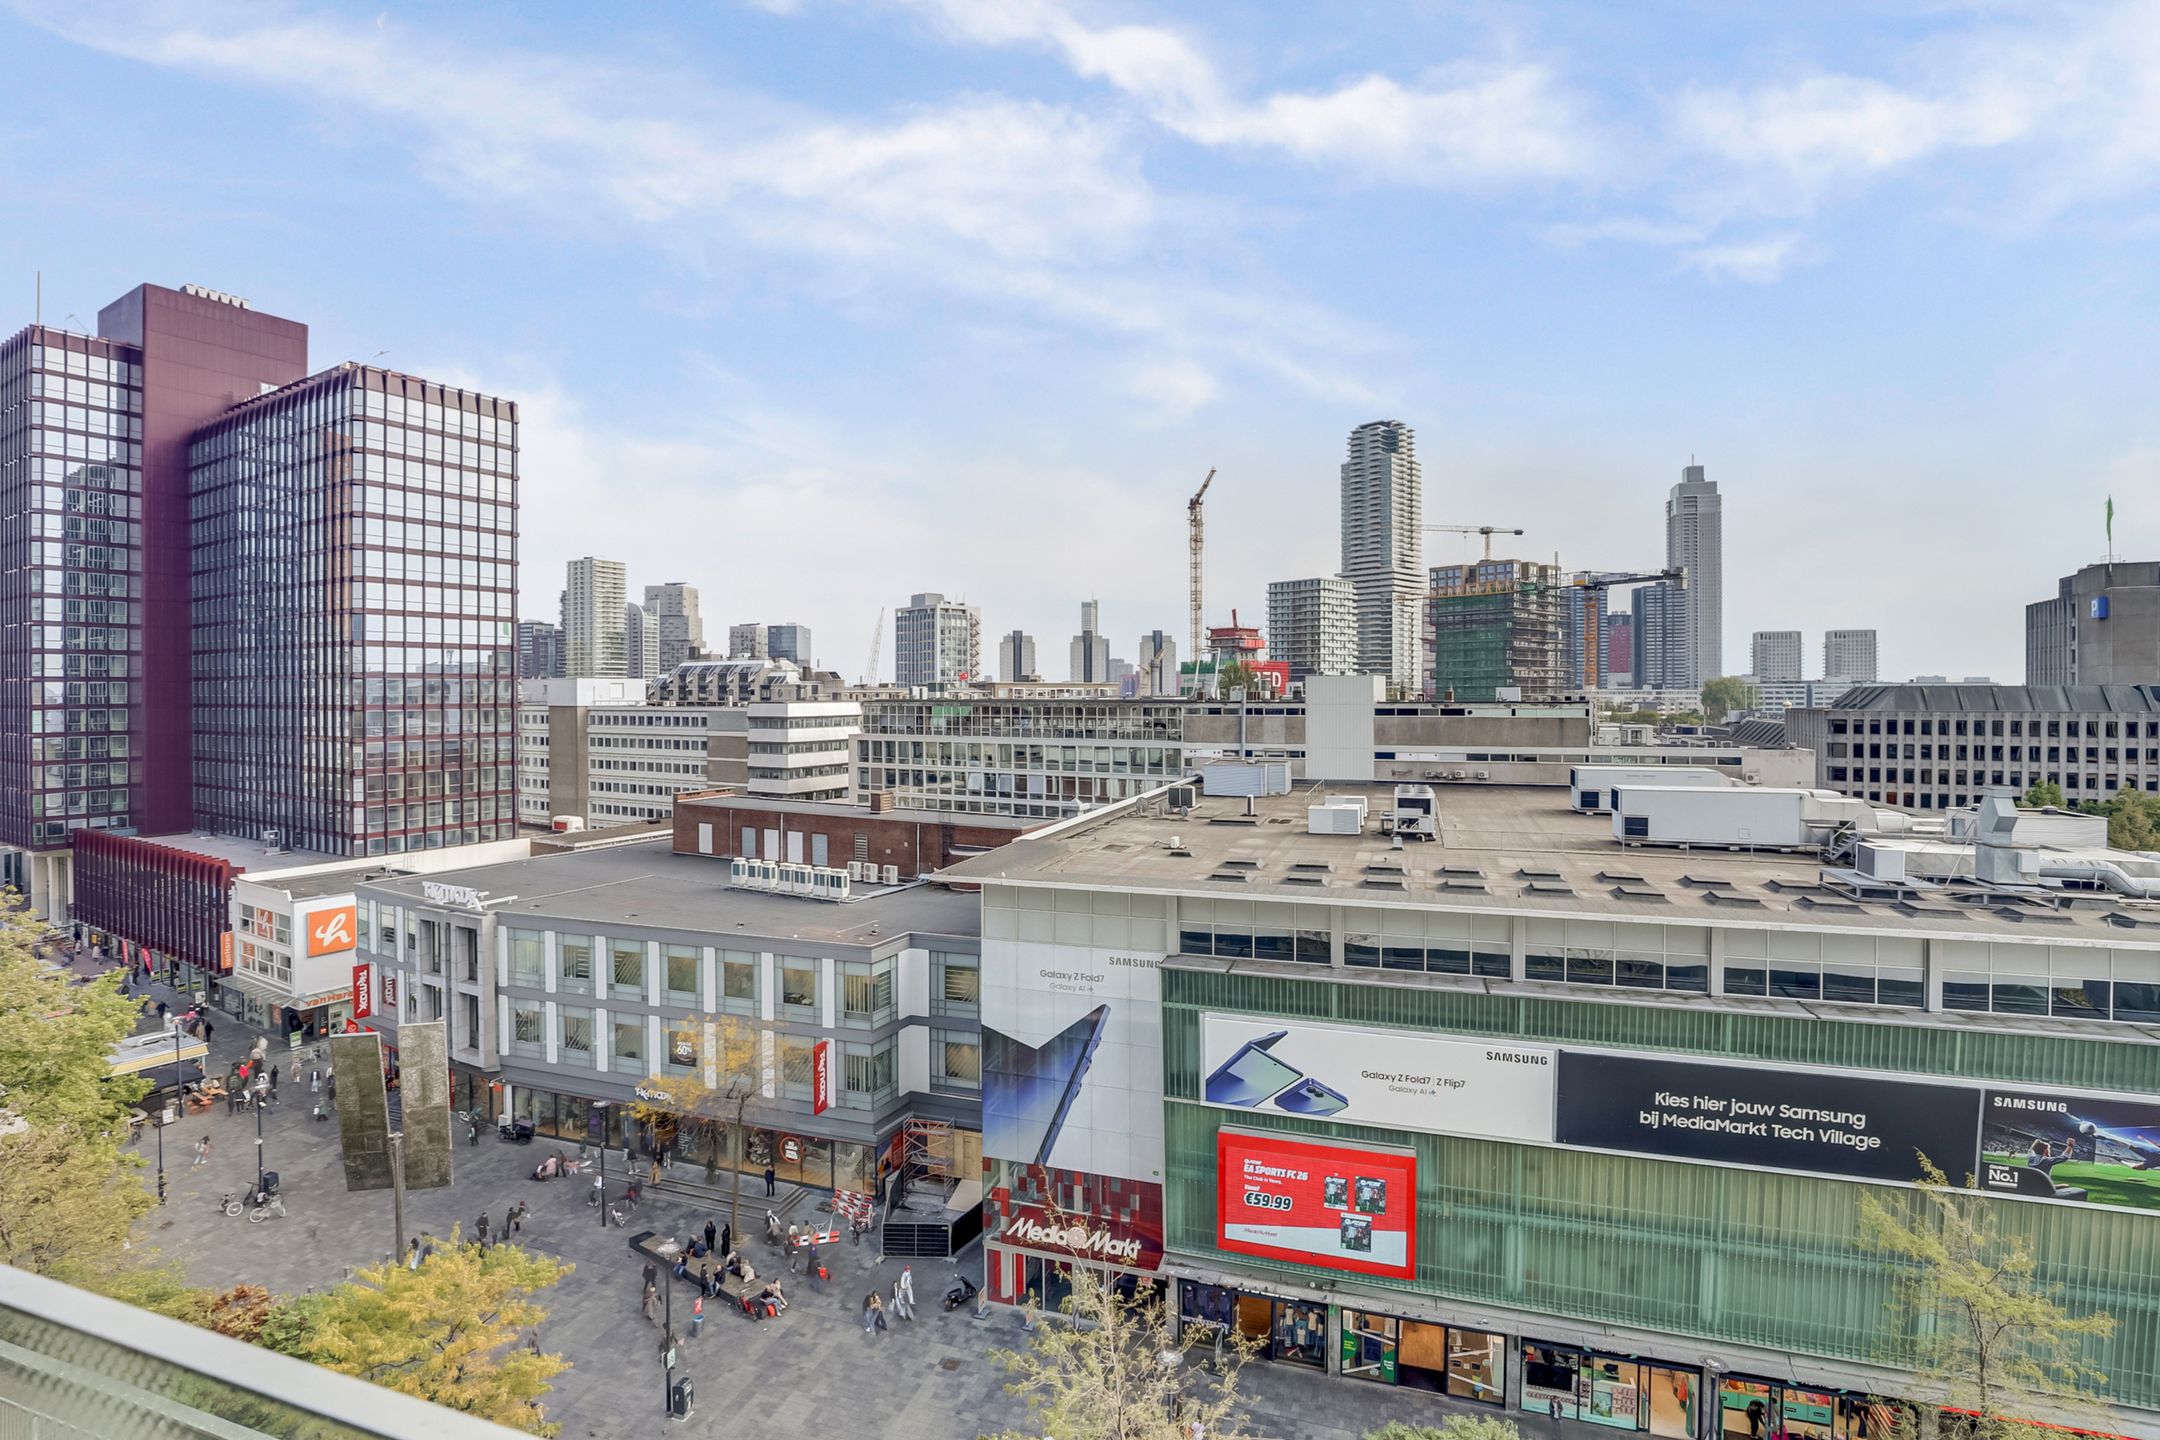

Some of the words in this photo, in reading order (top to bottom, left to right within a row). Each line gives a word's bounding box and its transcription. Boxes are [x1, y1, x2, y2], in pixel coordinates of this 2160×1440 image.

[2090, 599, 2098, 617] P
[1039, 969, 1072, 982] Galaxy
[1074, 972, 1079, 981] Z
[1080, 973, 1104, 983] Fold7
[1049, 982, 1077, 993] Galaxy
[1486, 1051, 1548, 1065] SAMSUNG
[1361, 1070, 1396, 1083] Galaxy
[1398, 1074, 1403, 1082] Z
[1405, 1074, 1431, 1085] Fold7
[1436, 1078, 1442, 1086] Z
[1444, 1079, 1466, 1089] Flip7
[1388, 1085, 1418, 1096] Galaxy
[1655, 1092, 1690, 1108] Kies
[1693, 1095, 1727, 1111] hier
[1729, 1098, 1775, 1117] jouw
[1779, 1104, 1866, 1130] Samsung
[1993, 1096, 2068, 1113] SAMSUNG
[1639, 1111, 1659, 1129] bij
[1663, 1113, 1767, 1137] MediaMarkt
[1771, 1123, 1814, 1142] Tech
[1818, 1129, 1881, 1152] Village
[1243, 1164, 1254, 1173] EA
[1254, 1166, 1286, 1178] SPORTS
[1286, 1169, 1296, 1179] FC
[1988, 1169, 2019, 1183] No.1
[1245, 1192, 1292, 1210] €59.99
